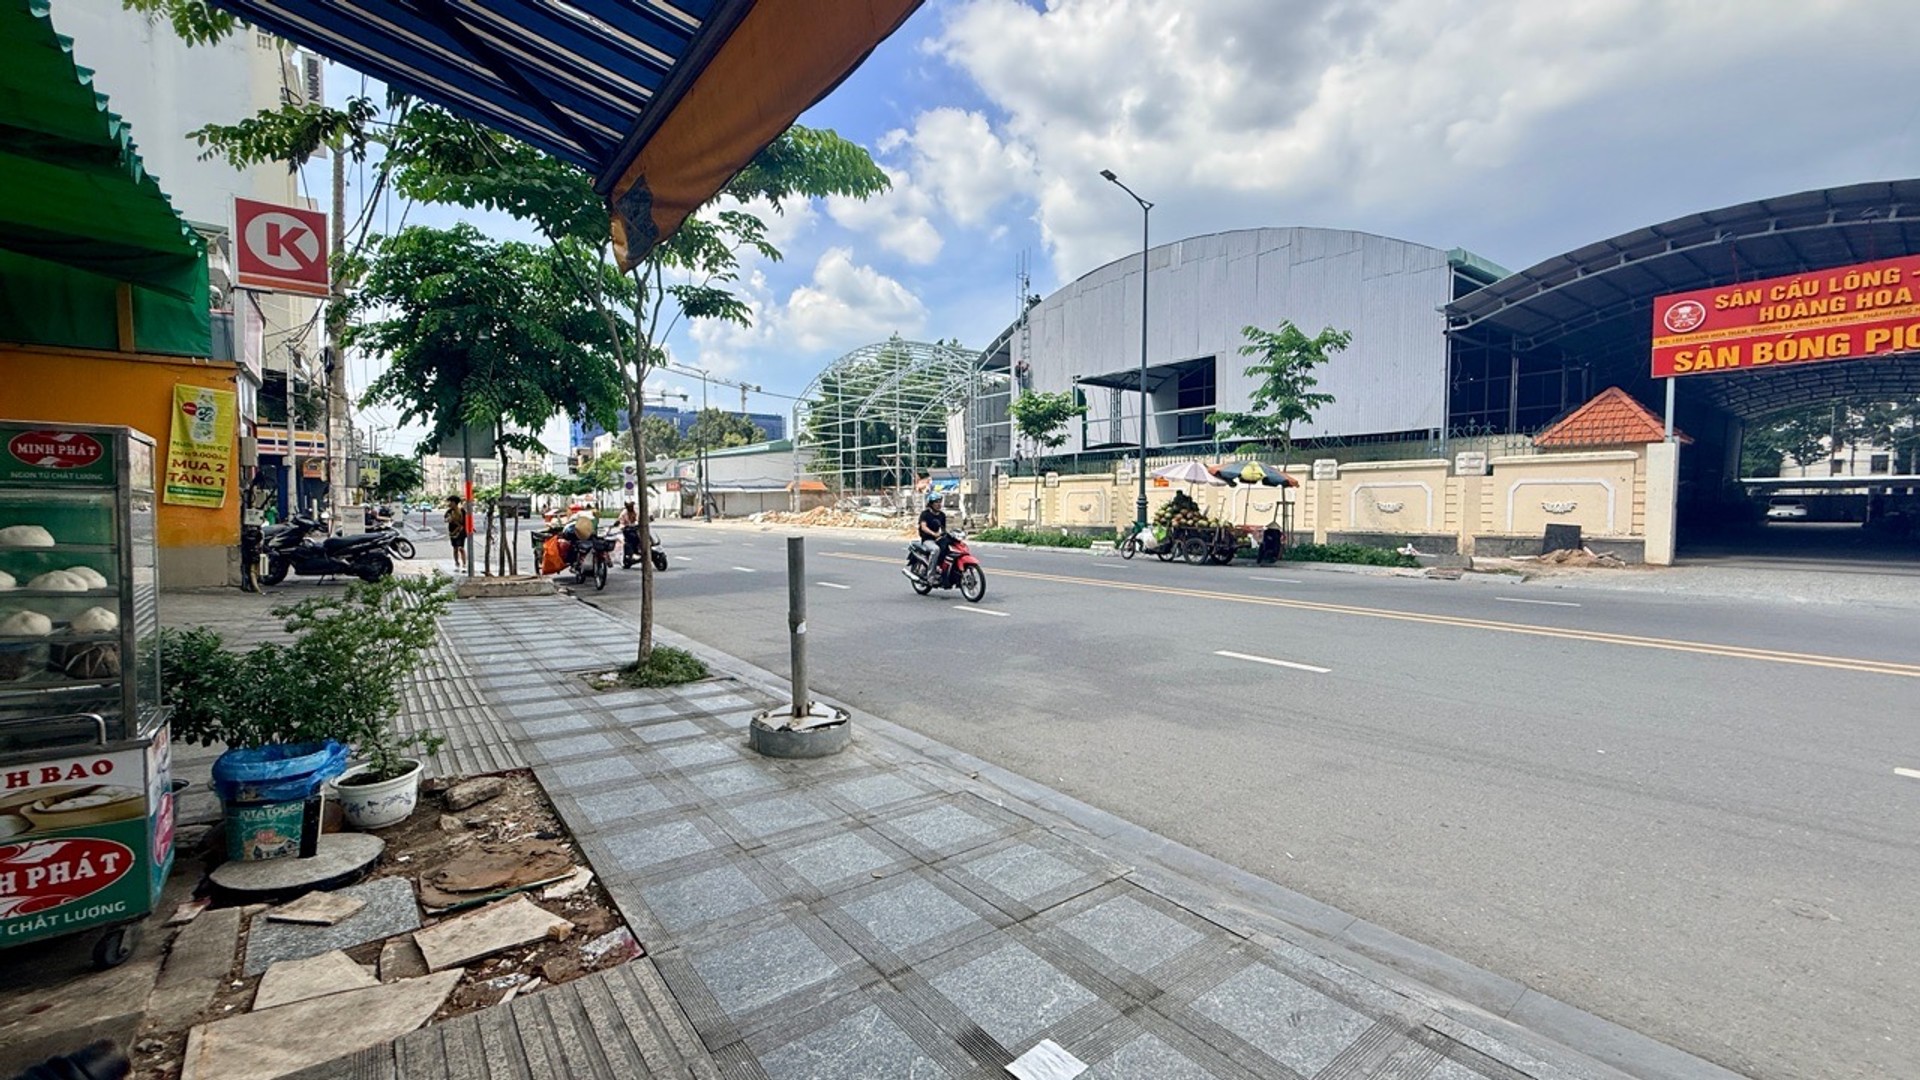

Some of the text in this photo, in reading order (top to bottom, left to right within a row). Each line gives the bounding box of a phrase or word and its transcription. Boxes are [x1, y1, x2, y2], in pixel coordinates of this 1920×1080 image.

[1714, 267, 1901, 310] SÂN CẦU LÔNG
[1758, 286, 1913, 322] HOÀNG HOA
[1673, 344, 1740, 372] SÂN
[1752, 332, 1851, 365] BÓNG
[17, 442, 97, 456] MINH PHÁT
[172, 459, 225, 473] MUA 2
[168, 472, 226, 486] TẶNG 1
[40, 759, 114, 784] BAO
[26, 851, 120, 889] PHÁT
[64, 901, 126, 923] LƯỢNG
